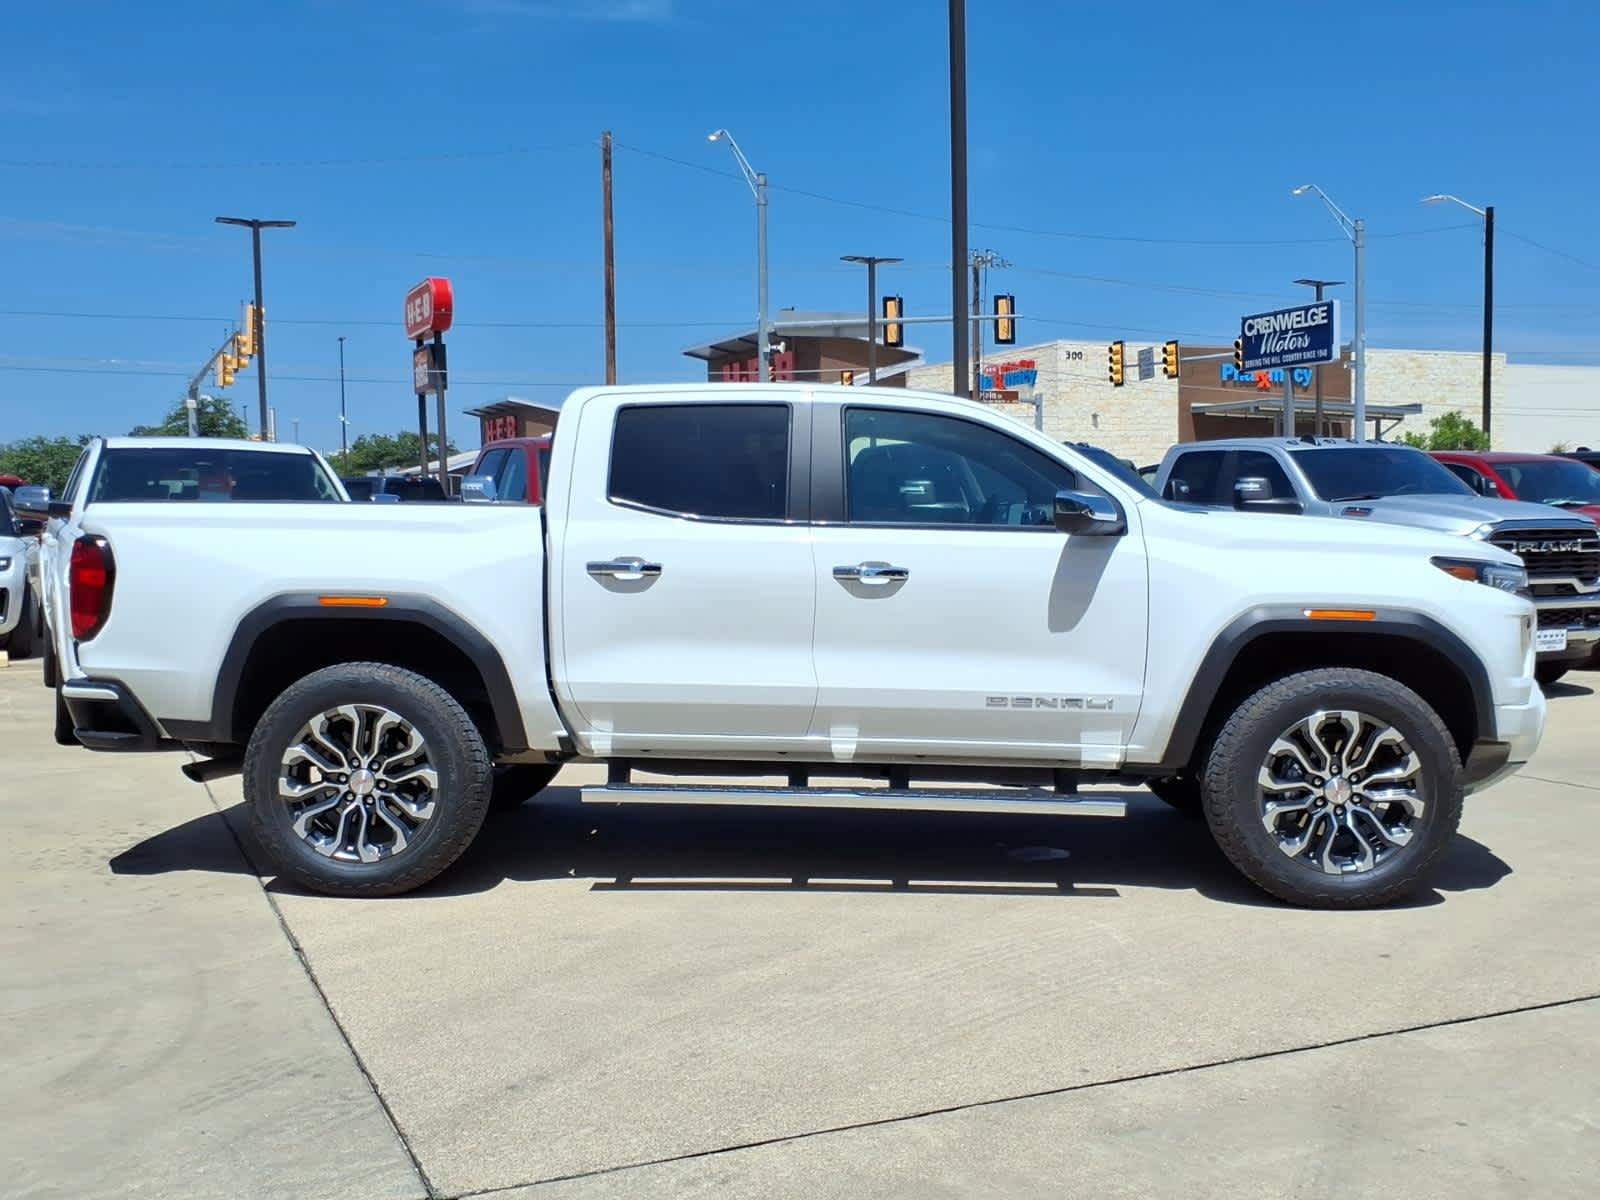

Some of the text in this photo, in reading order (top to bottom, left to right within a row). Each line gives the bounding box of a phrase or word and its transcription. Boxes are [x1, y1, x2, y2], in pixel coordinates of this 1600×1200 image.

[1244, 306, 1328, 337] CRENWELGE
[1260, 330, 1310, 355] Motors
[1065, 351, 1083, 361] 300
[985, 696, 1113, 710] DENALI
